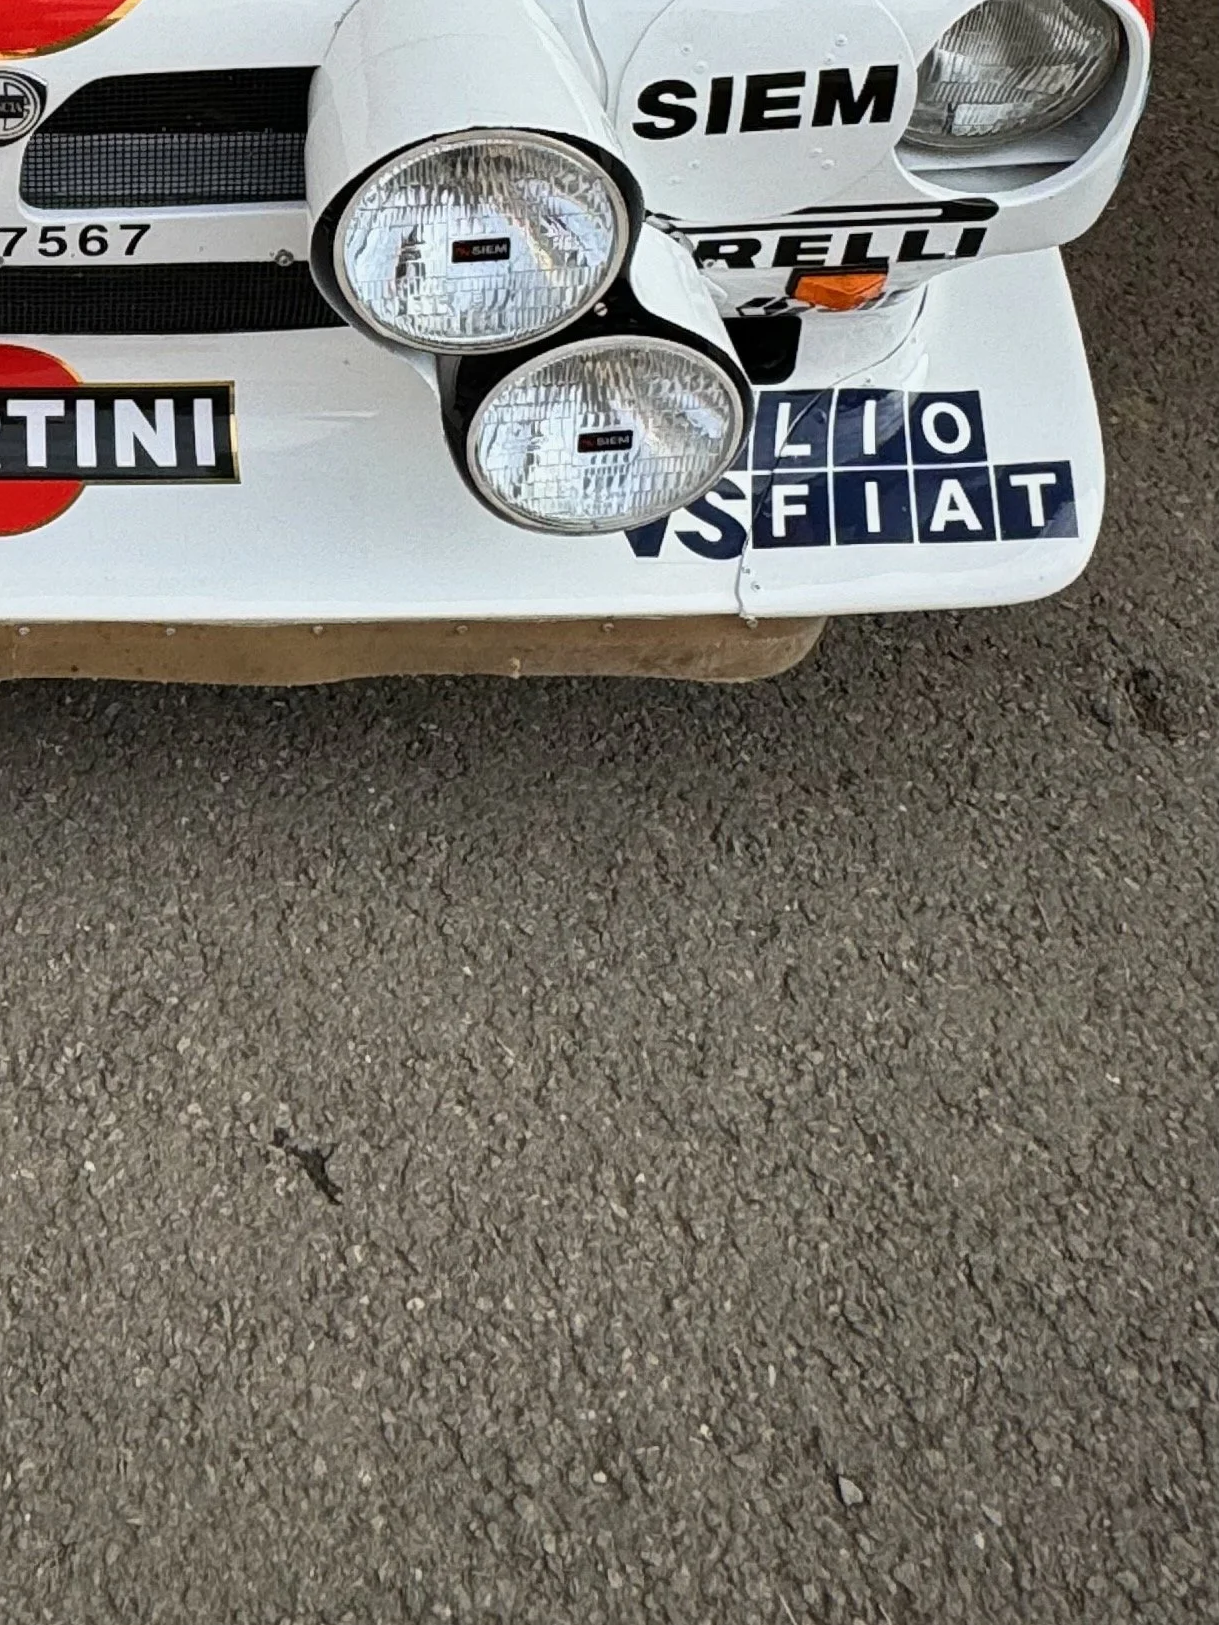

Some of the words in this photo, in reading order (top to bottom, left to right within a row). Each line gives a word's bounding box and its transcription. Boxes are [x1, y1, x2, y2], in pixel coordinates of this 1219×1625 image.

[632, 63, 899, 141] SIEM
[471, 243, 508, 255] SIEM
[772, 398, 973, 458] LIO
